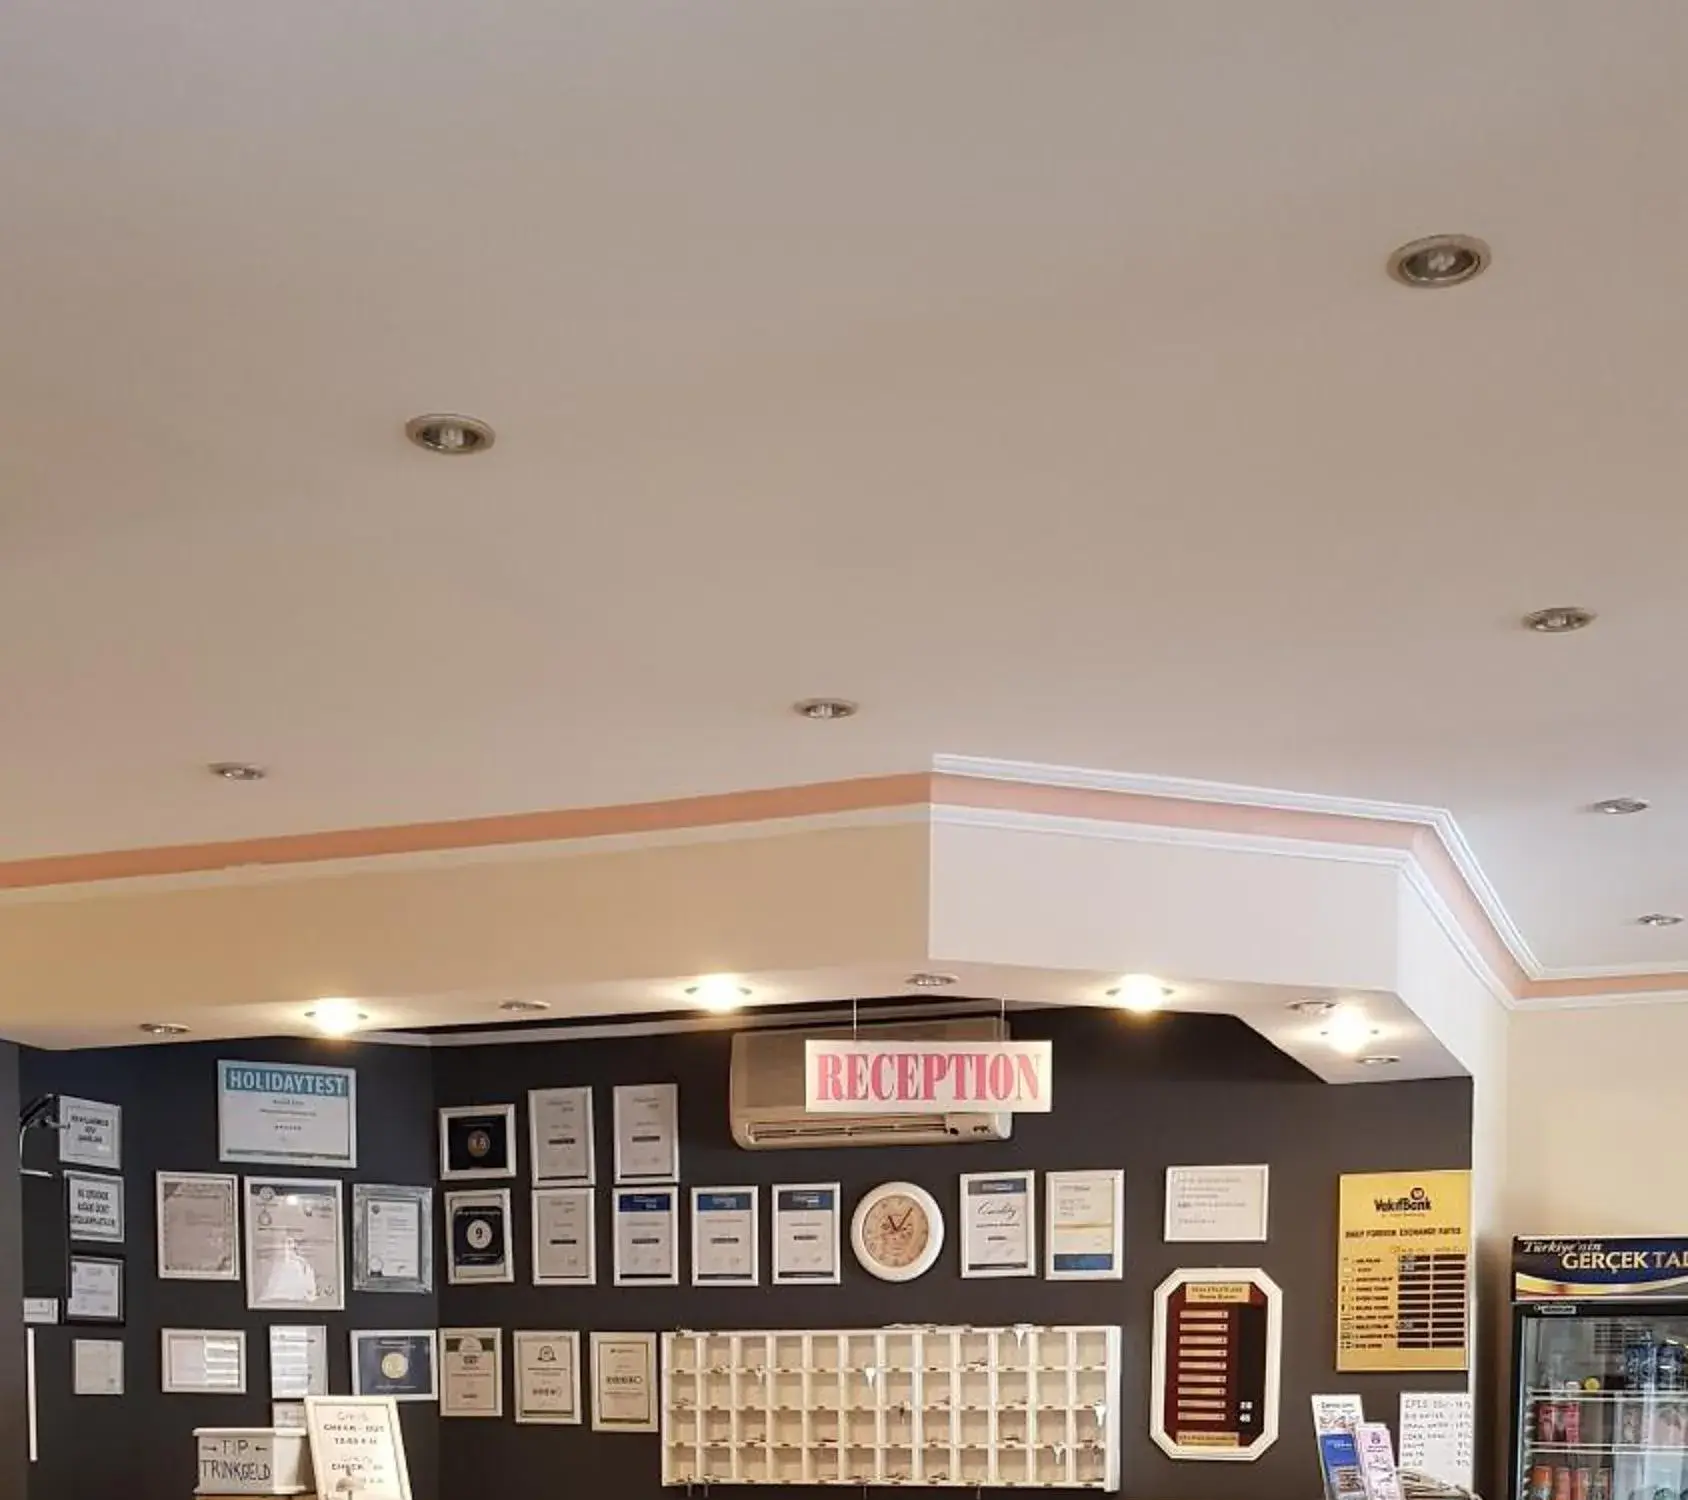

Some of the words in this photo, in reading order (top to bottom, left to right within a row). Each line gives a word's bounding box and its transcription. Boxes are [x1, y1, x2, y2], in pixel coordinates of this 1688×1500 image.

[230, 1070, 345, 1094] HOLIDAYTEST
[816, 1053, 1041, 1101] RECEPTION
[1523, 1241, 1603, 1256] Türkiye'nin
[1562, 1252, 1648, 1273] GERÇEK
[222, 1439, 249, 1455] TIP
[200, 1459, 271, 1481] TRINKGELD
